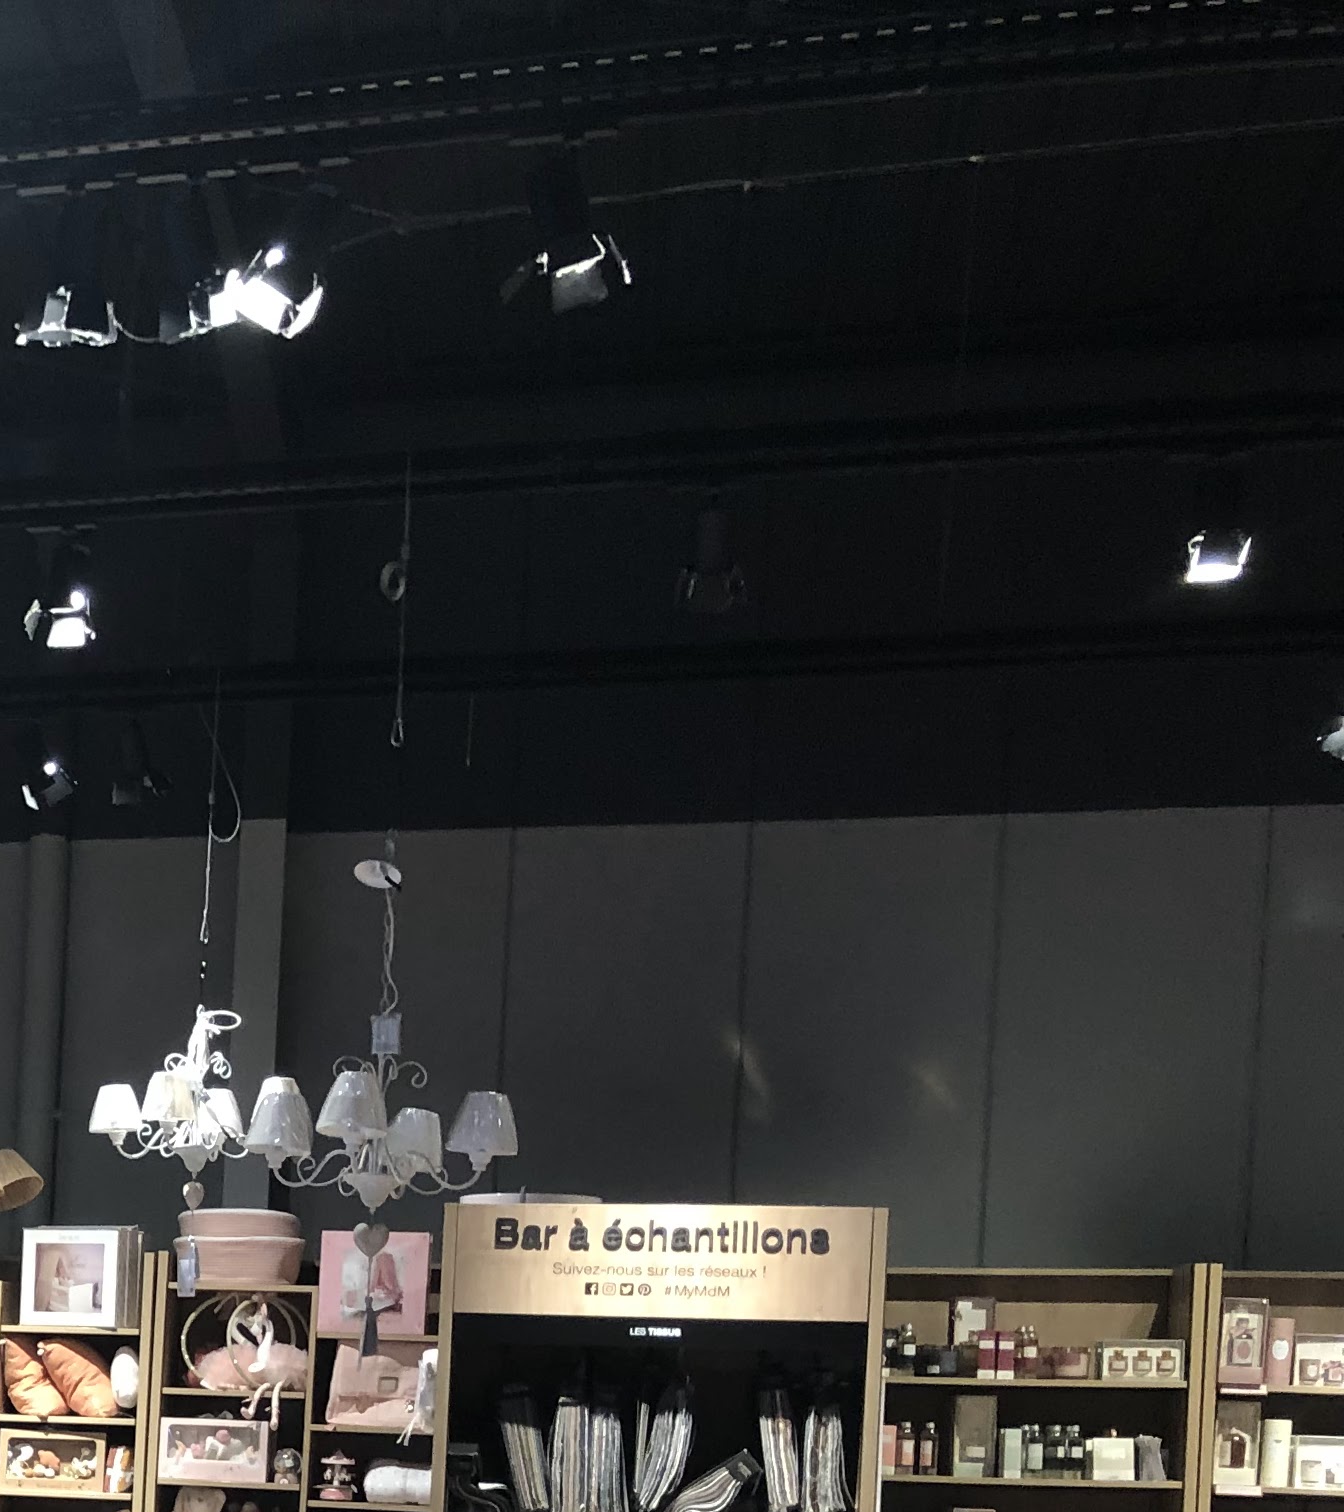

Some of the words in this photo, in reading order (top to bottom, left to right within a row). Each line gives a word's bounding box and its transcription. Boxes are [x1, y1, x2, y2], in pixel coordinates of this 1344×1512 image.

[494, 1217, 559, 1250] Bar
[568, 1218, 591, 1251] à
[602, 1218, 831, 1256] échantillons
[552, 1262, 643, 1277] Suivez-nous
[647, 1265, 670, 1277] sur
[674, 1264, 695, 1277] les
[699, 1263, 758, 1279] réseaux
[629, 1327, 646, 1336] LES
